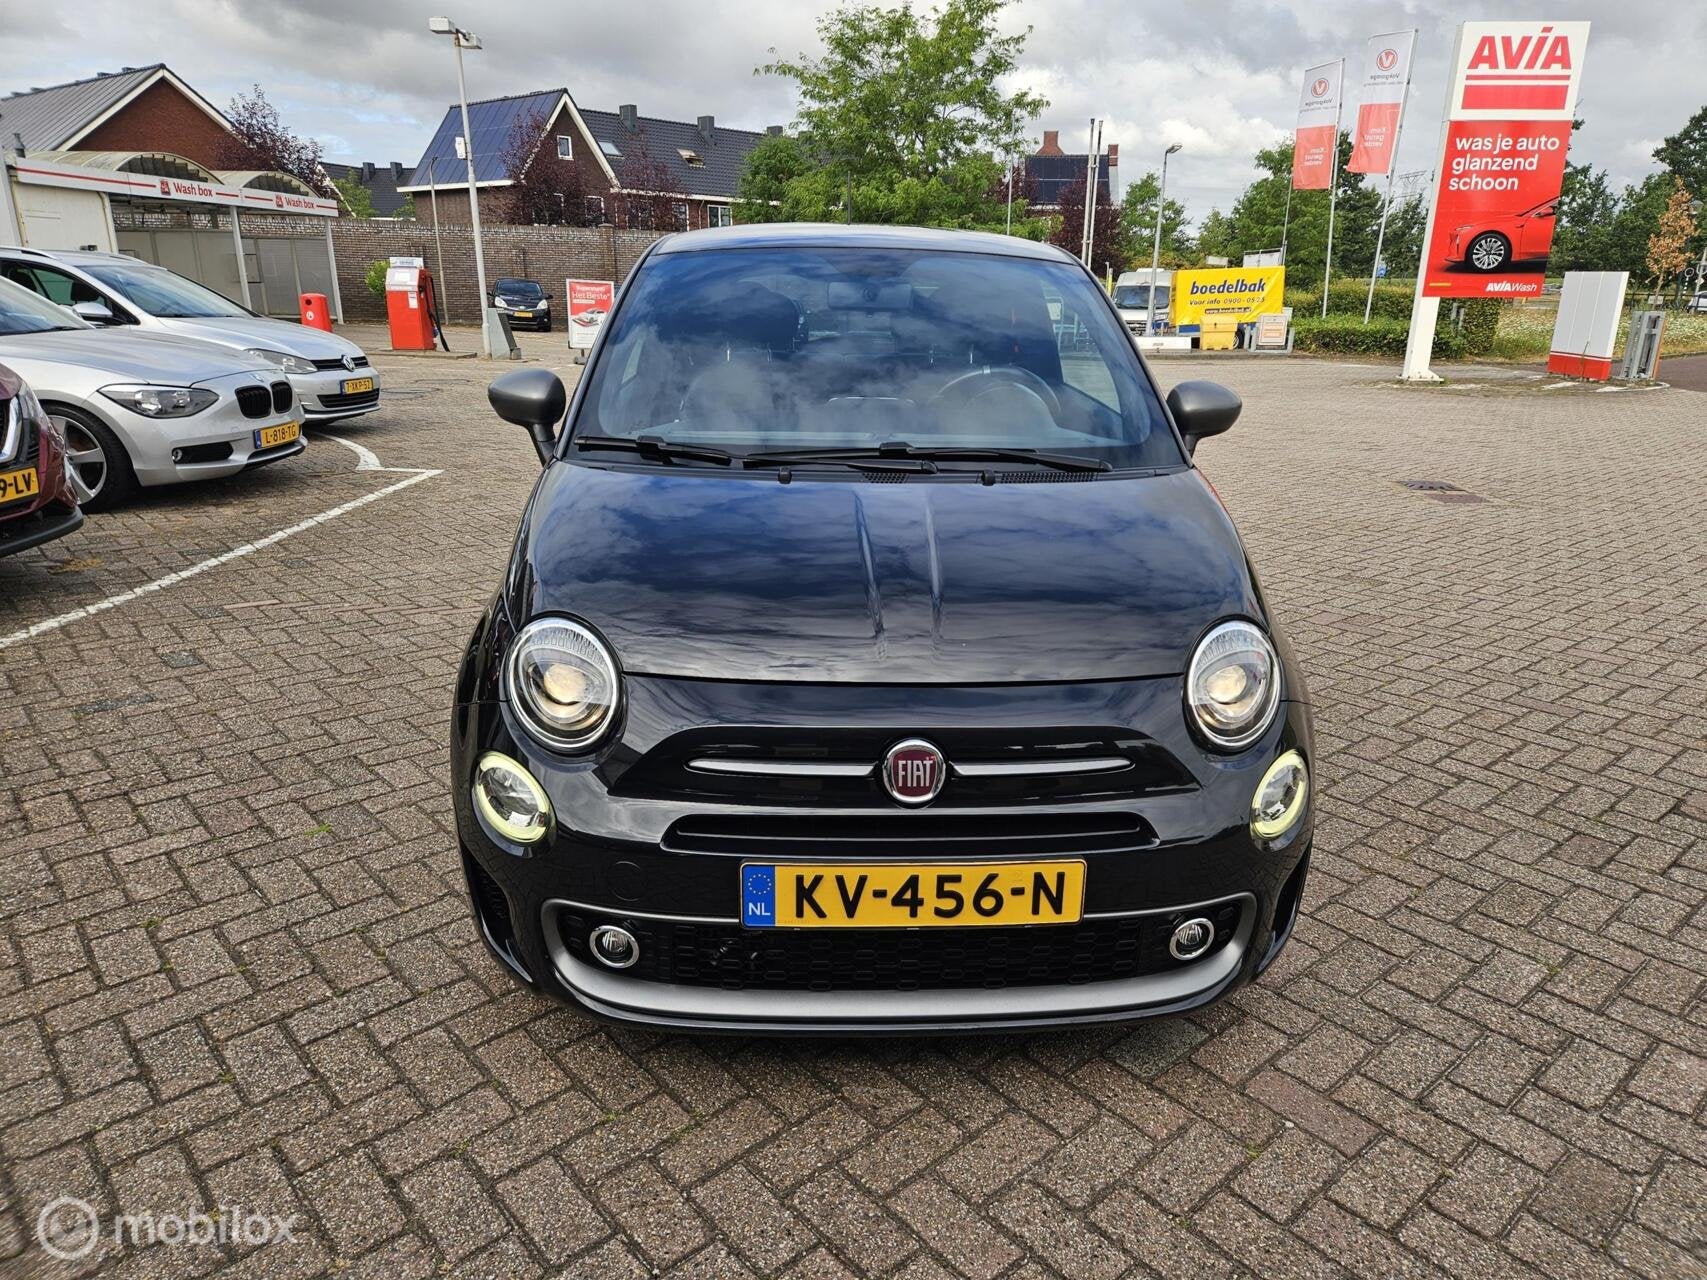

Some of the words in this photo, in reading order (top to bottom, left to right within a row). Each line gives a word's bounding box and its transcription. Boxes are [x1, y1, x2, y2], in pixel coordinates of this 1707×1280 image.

[1455, 137, 1493, 150] was
[1493, 133, 1513, 154] je
[1516, 135, 1560, 150] auto
[1452, 154, 1538, 175] glanzend
[173, 182, 197, 195] Wash
[198, 186, 213, 198] box
[1449, 174, 1519, 190] schoon
[285, 196, 302, 208] Wash
[303, 200, 315, 209] box
[1190, 278, 1266, 295] boedelbak
[265, 424, 296, 444] L-818-TG
[898, 758, 935, 787] FIAT
[795, 871, 1066, 919] KV-456-N
[748, 902, 771, 916] NL
